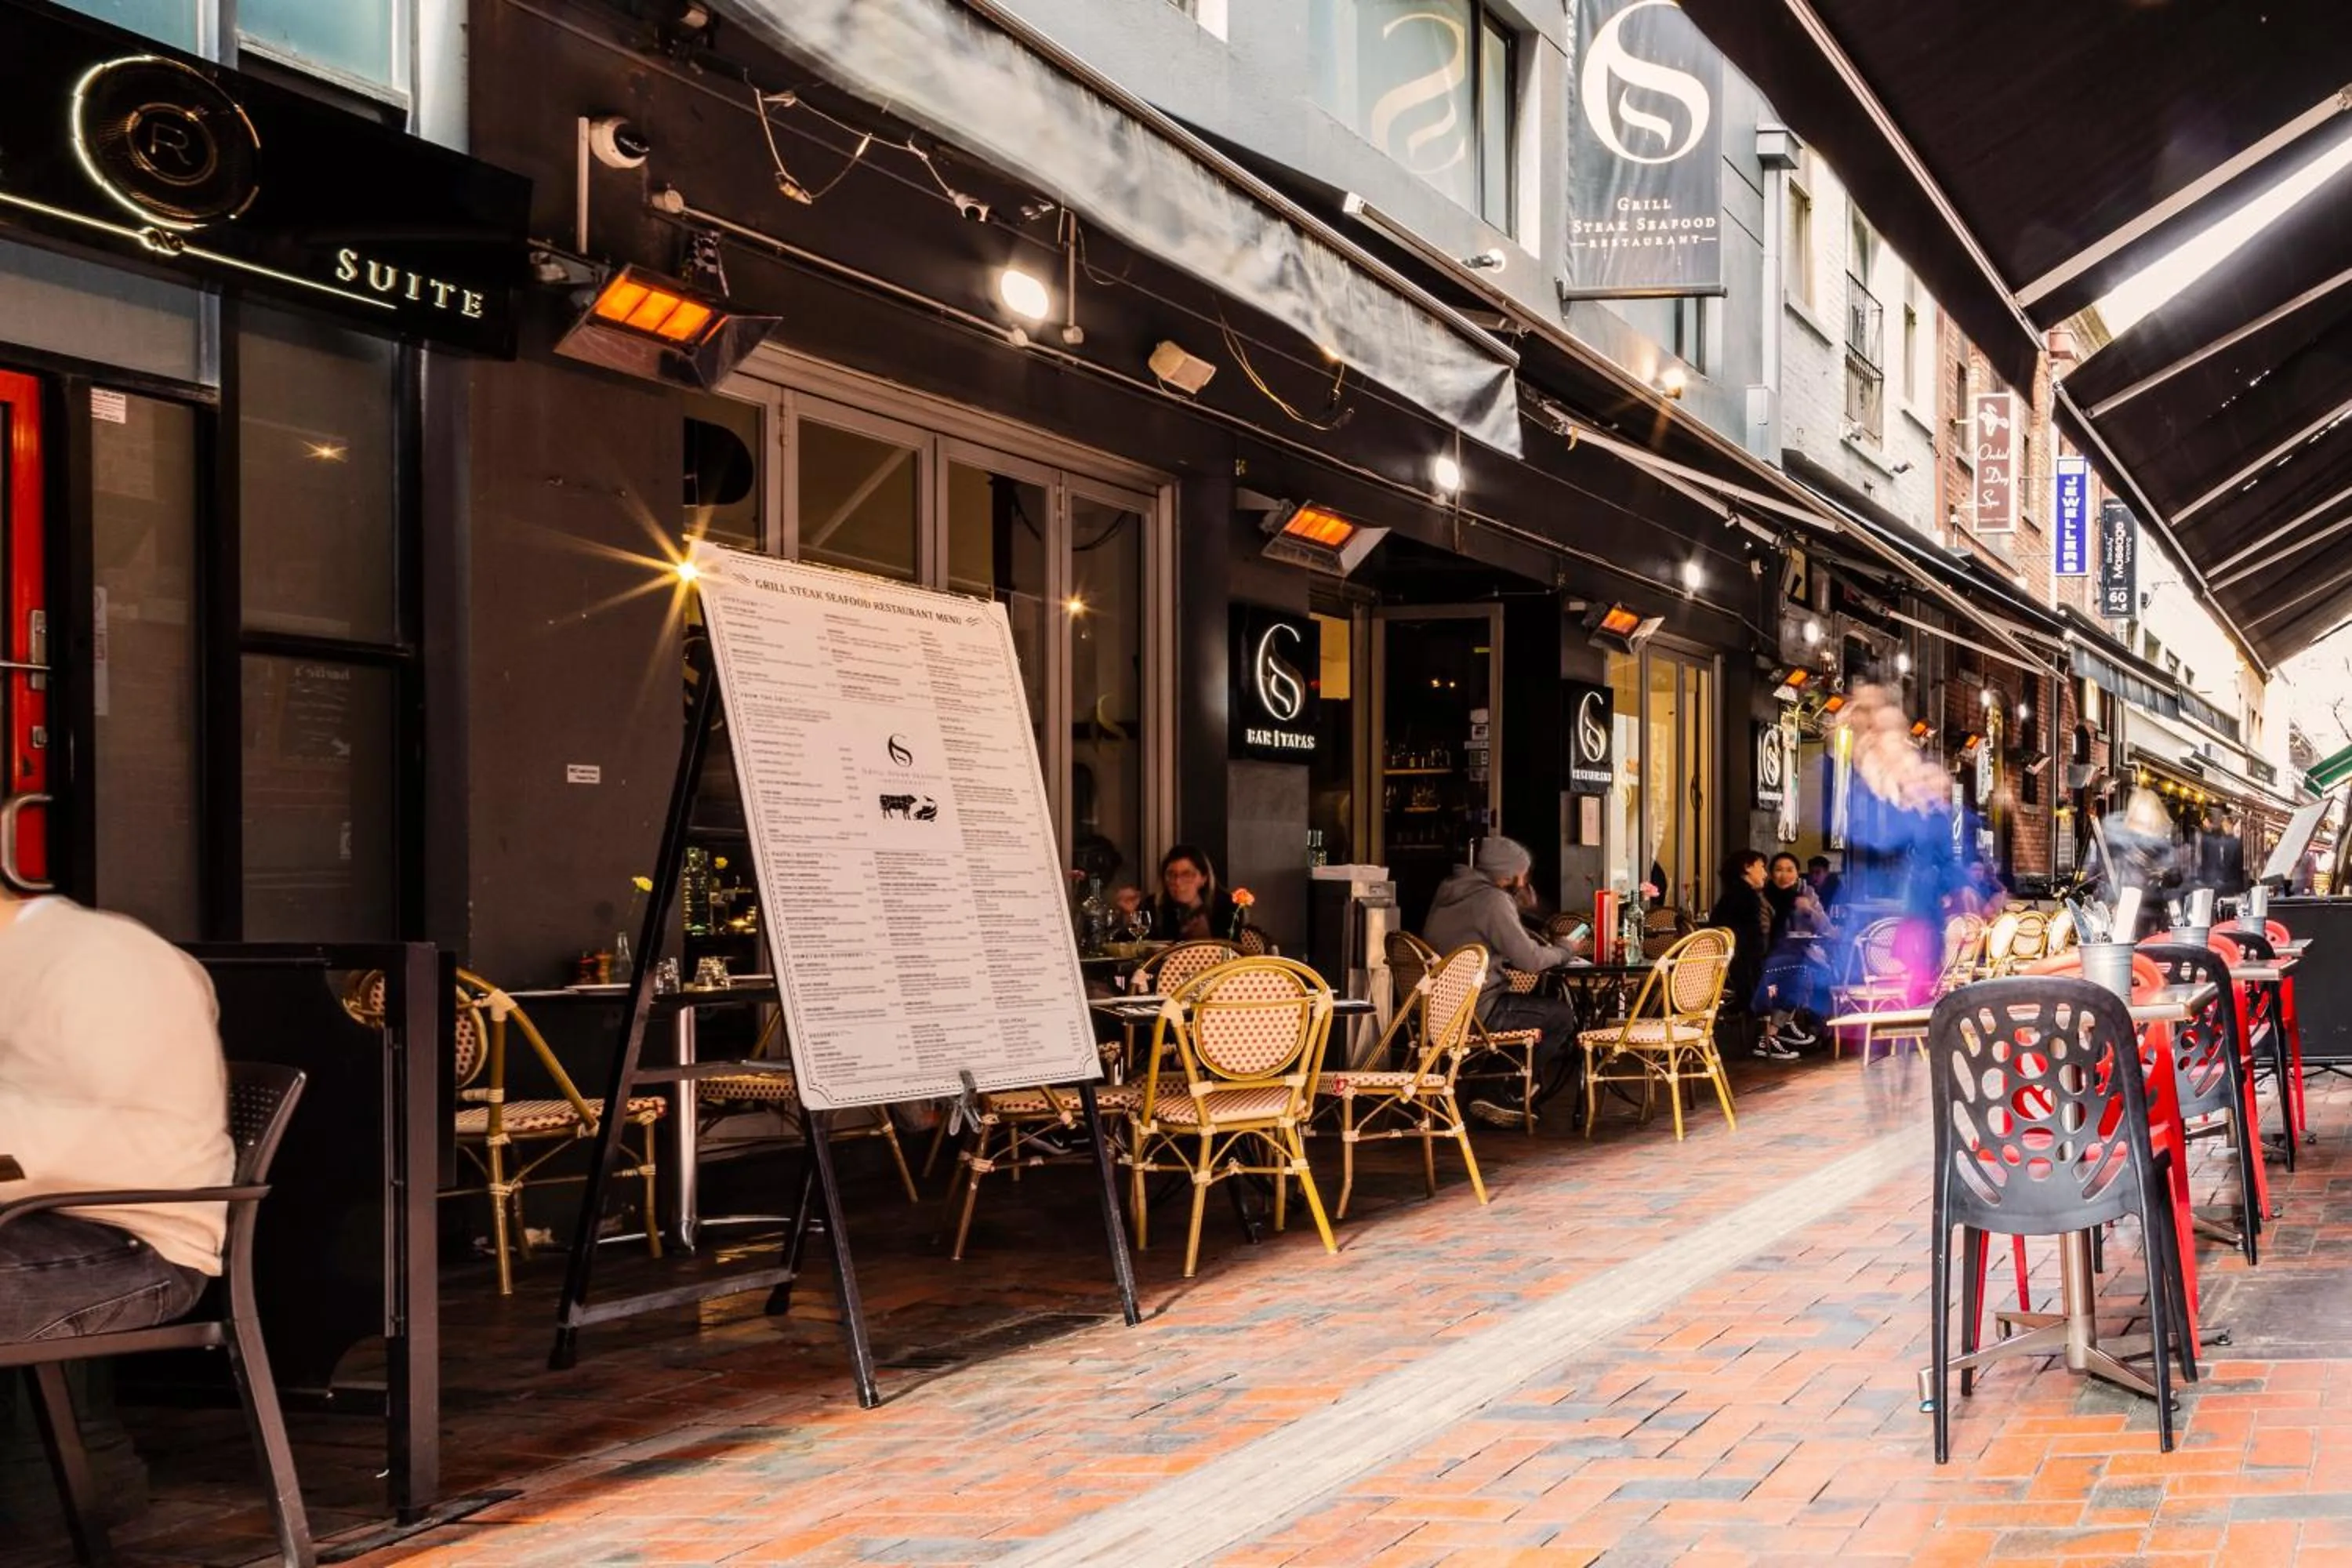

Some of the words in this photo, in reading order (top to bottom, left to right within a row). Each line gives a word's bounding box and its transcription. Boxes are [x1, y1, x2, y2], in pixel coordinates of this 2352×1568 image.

[151, 122, 192, 165] R
[1617, 197, 1671, 211] GRILL
[1572, 220, 1628, 234] STEAK
[1636, 216, 1717, 231] SEAFOOD
[1589, 235, 1700, 249] RESTAURANT
[336, 248, 484, 318] SUITE
[755, 579, 787, 593] GRILL
[789, 586, 823, 600] STEAK
[825, 591, 871, 609] SEAFOOD
[873, 601, 933, 621] RESTAURANT
[935, 612, 962, 625] MENU
[1246, 728, 1272, 746] BAR
[1280, 731, 1315, 749] TAPAS
